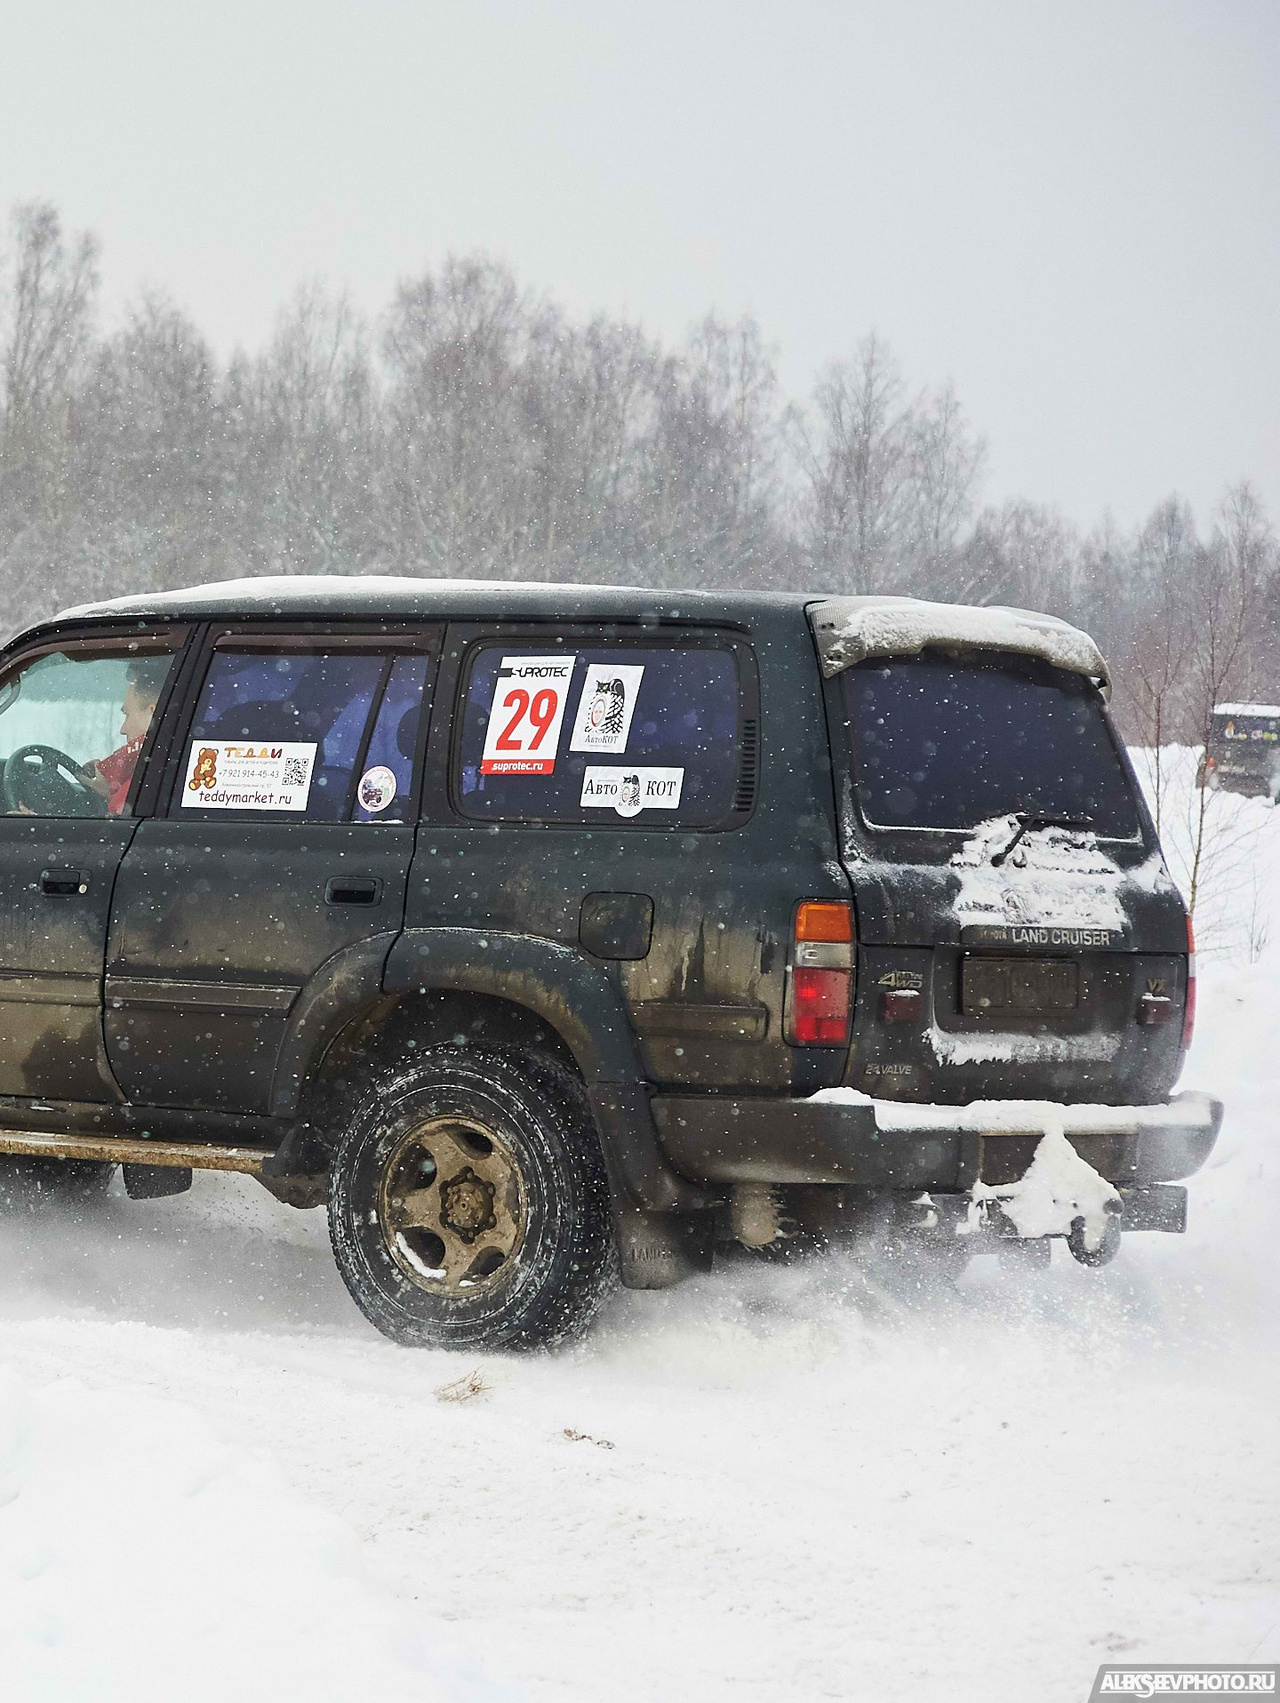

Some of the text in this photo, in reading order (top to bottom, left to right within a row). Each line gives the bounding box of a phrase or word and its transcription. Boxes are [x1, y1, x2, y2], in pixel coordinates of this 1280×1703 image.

[511, 667, 569, 677] SUPROTEC
[496, 689, 558, 750] 29
[228, 769, 241, 777] 921
[242, 769, 280, 778] 914-45-43
[492, 761, 543, 773] suprotec.ru
[646, 781, 676, 796] КОТ
[199, 790, 292, 806] teddymarket.ru
[1012, 929, 1048, 943] LAND
[1052, 930, 1110, 945] CRUISER
[881, 1064, 912, 1075] VALVE
